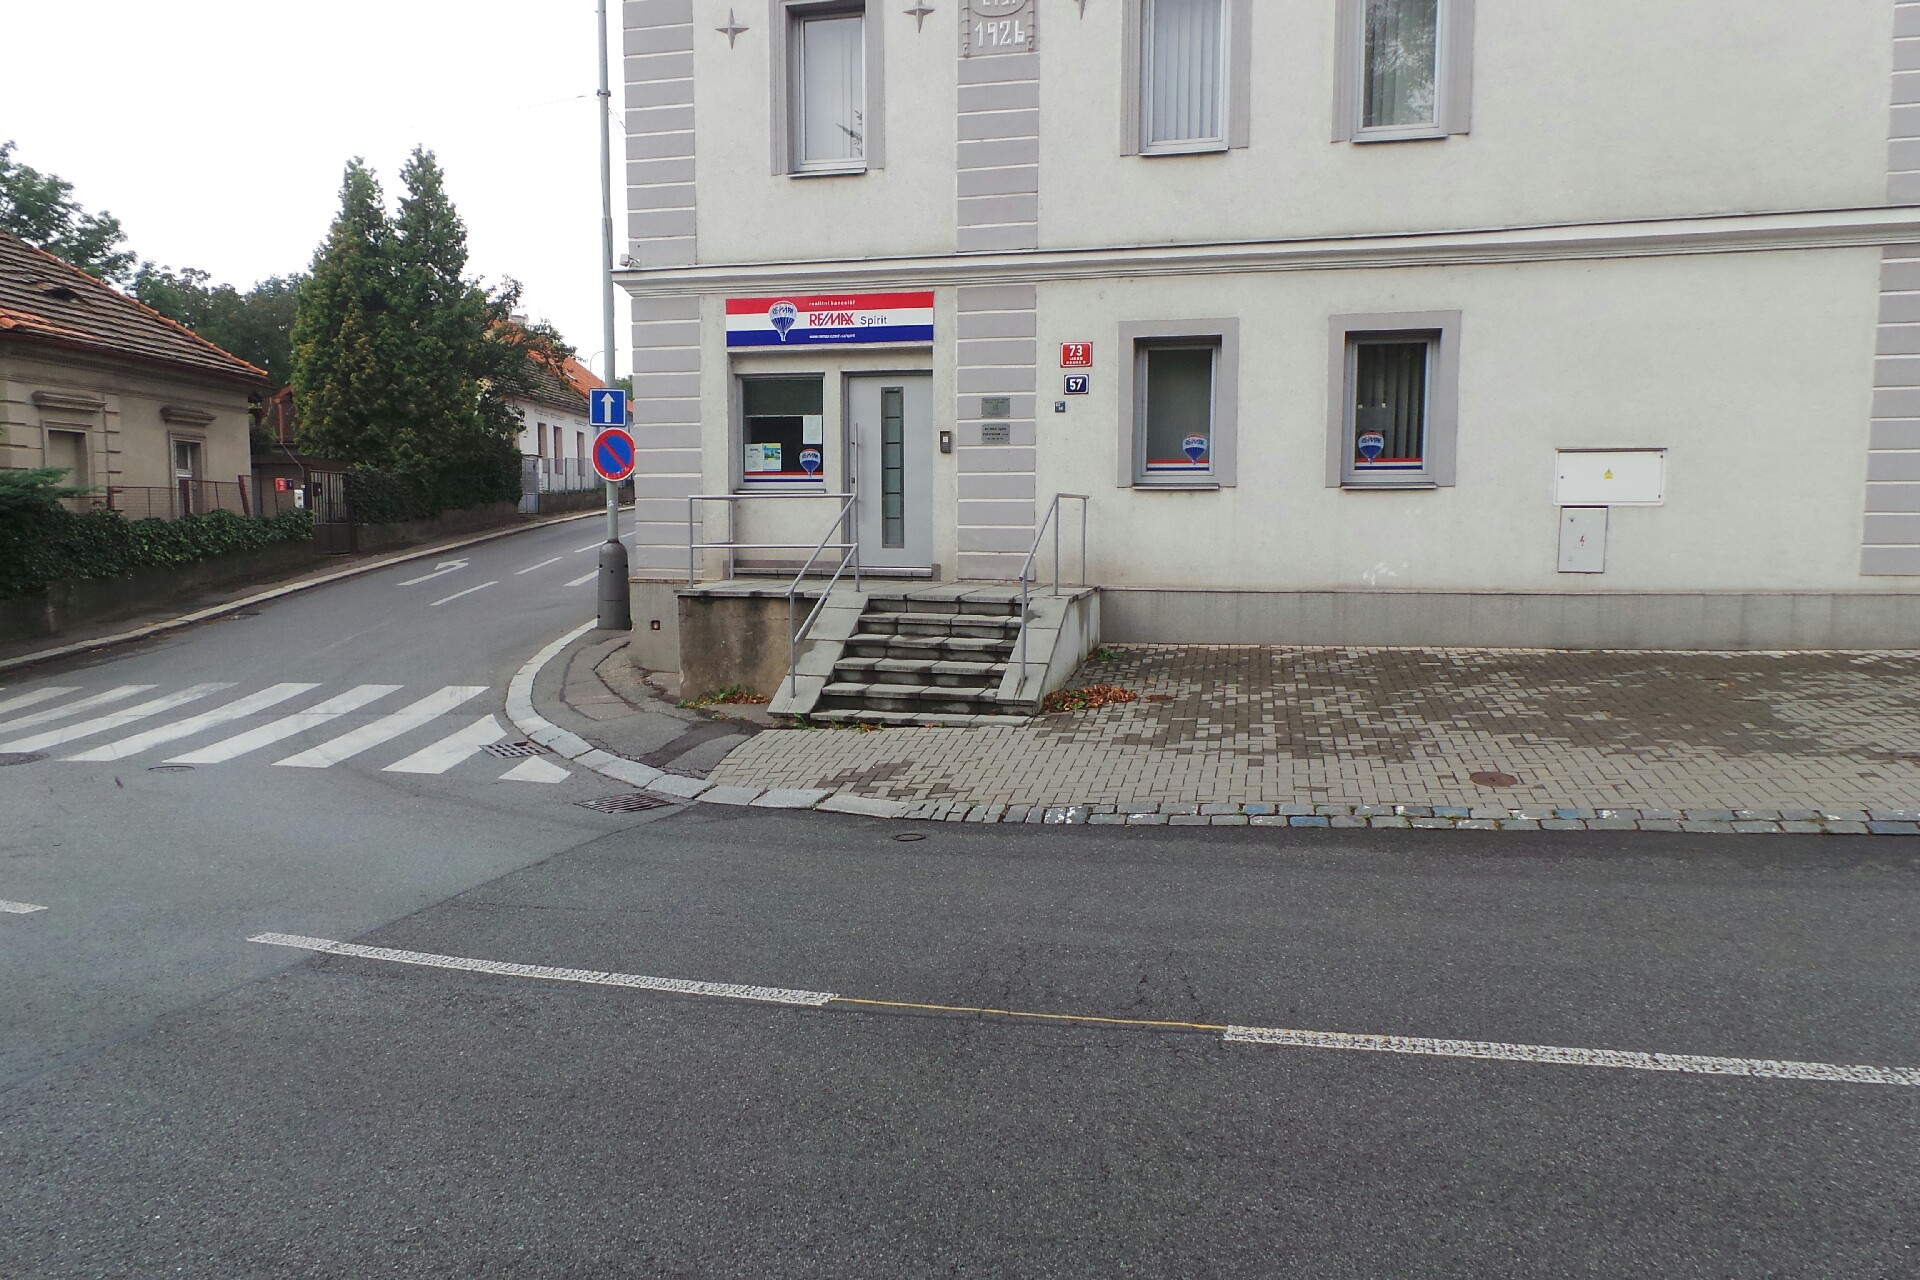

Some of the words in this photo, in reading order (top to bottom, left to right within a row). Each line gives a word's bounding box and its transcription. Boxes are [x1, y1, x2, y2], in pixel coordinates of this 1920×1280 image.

[974, 20, 1026, 48] 1926
[809, 312, 855, 327] RE/MAX
[860, 315, 888, 327] Spirit
[1069, 345, 1083, 357] 73
[1069, 378, 1083, 391] 57
